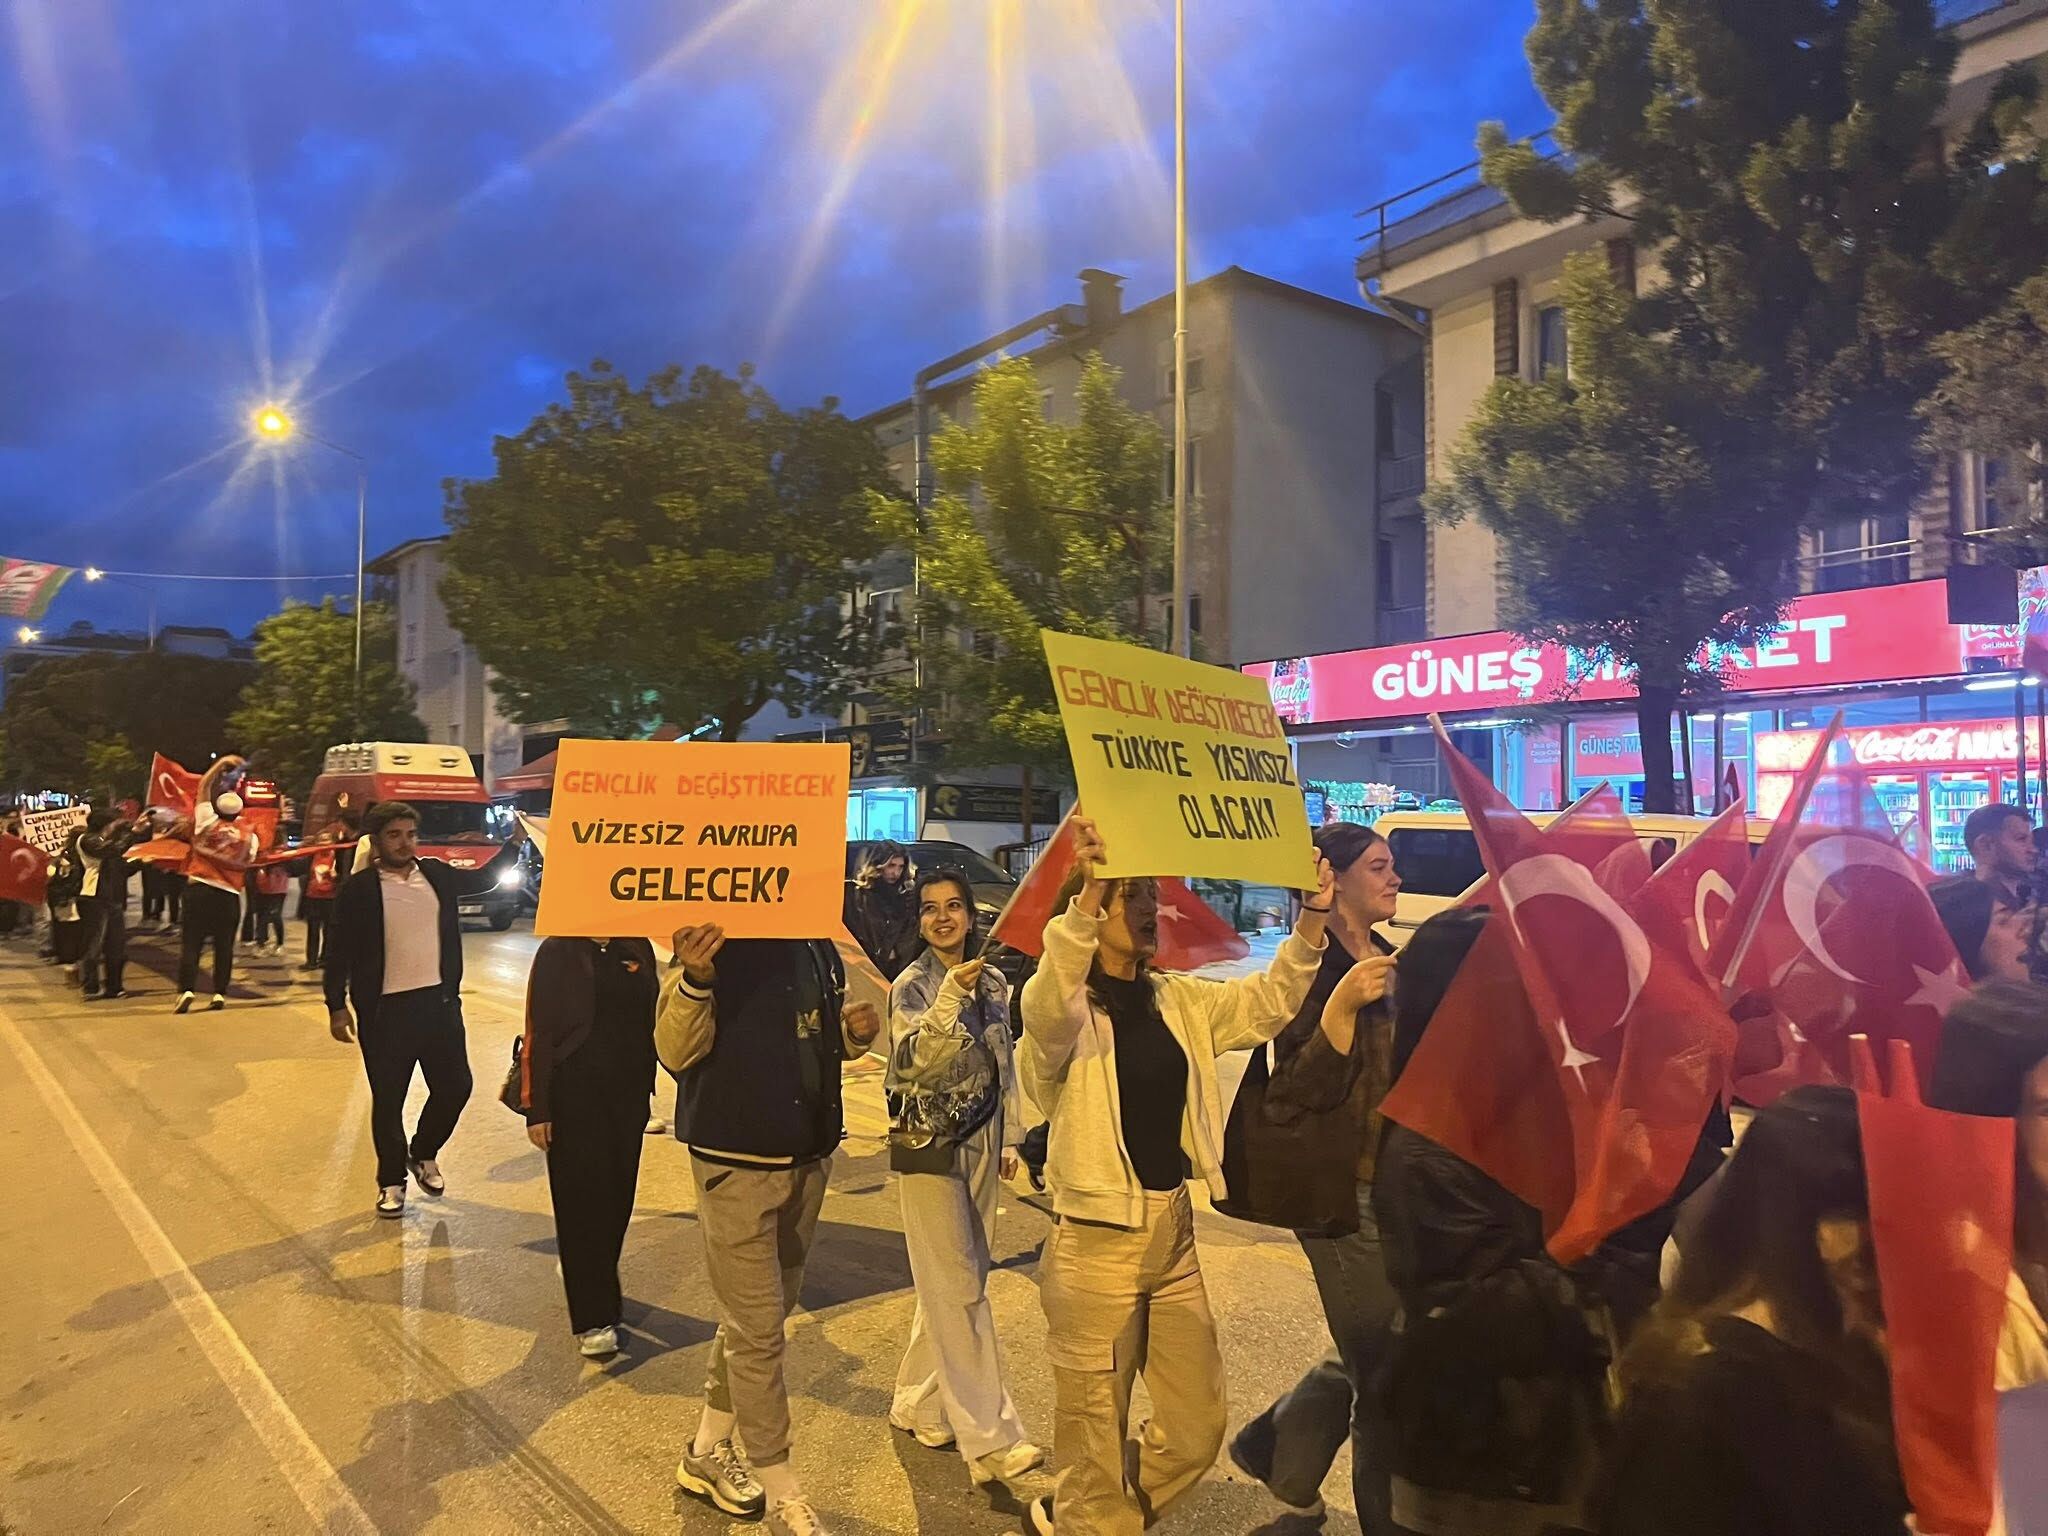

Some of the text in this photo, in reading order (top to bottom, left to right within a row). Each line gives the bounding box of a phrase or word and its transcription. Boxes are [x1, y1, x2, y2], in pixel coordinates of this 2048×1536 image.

[1372, 649, 1543, 700] GÜNEŞ
[1057, 665, 1282, 738] GENÇLİK DEĞİŞTİRECEK
[1092, 729, 1295, 786] TÜRKİYE YASAKSIZ
[1581, 734, 1621, 757] GÜNEŞ
[1855, 727, 1961, 764] Coca-Cola
[562, 770, 836, 799] GENÇLİK DEĞİŞTİRECEK
[572, 818, 797, 846] VİZESİZ AVRUPA
[1178, 794, 1280, 839] OLACAK!
[610, 867, 790, 903] GELECEK!
